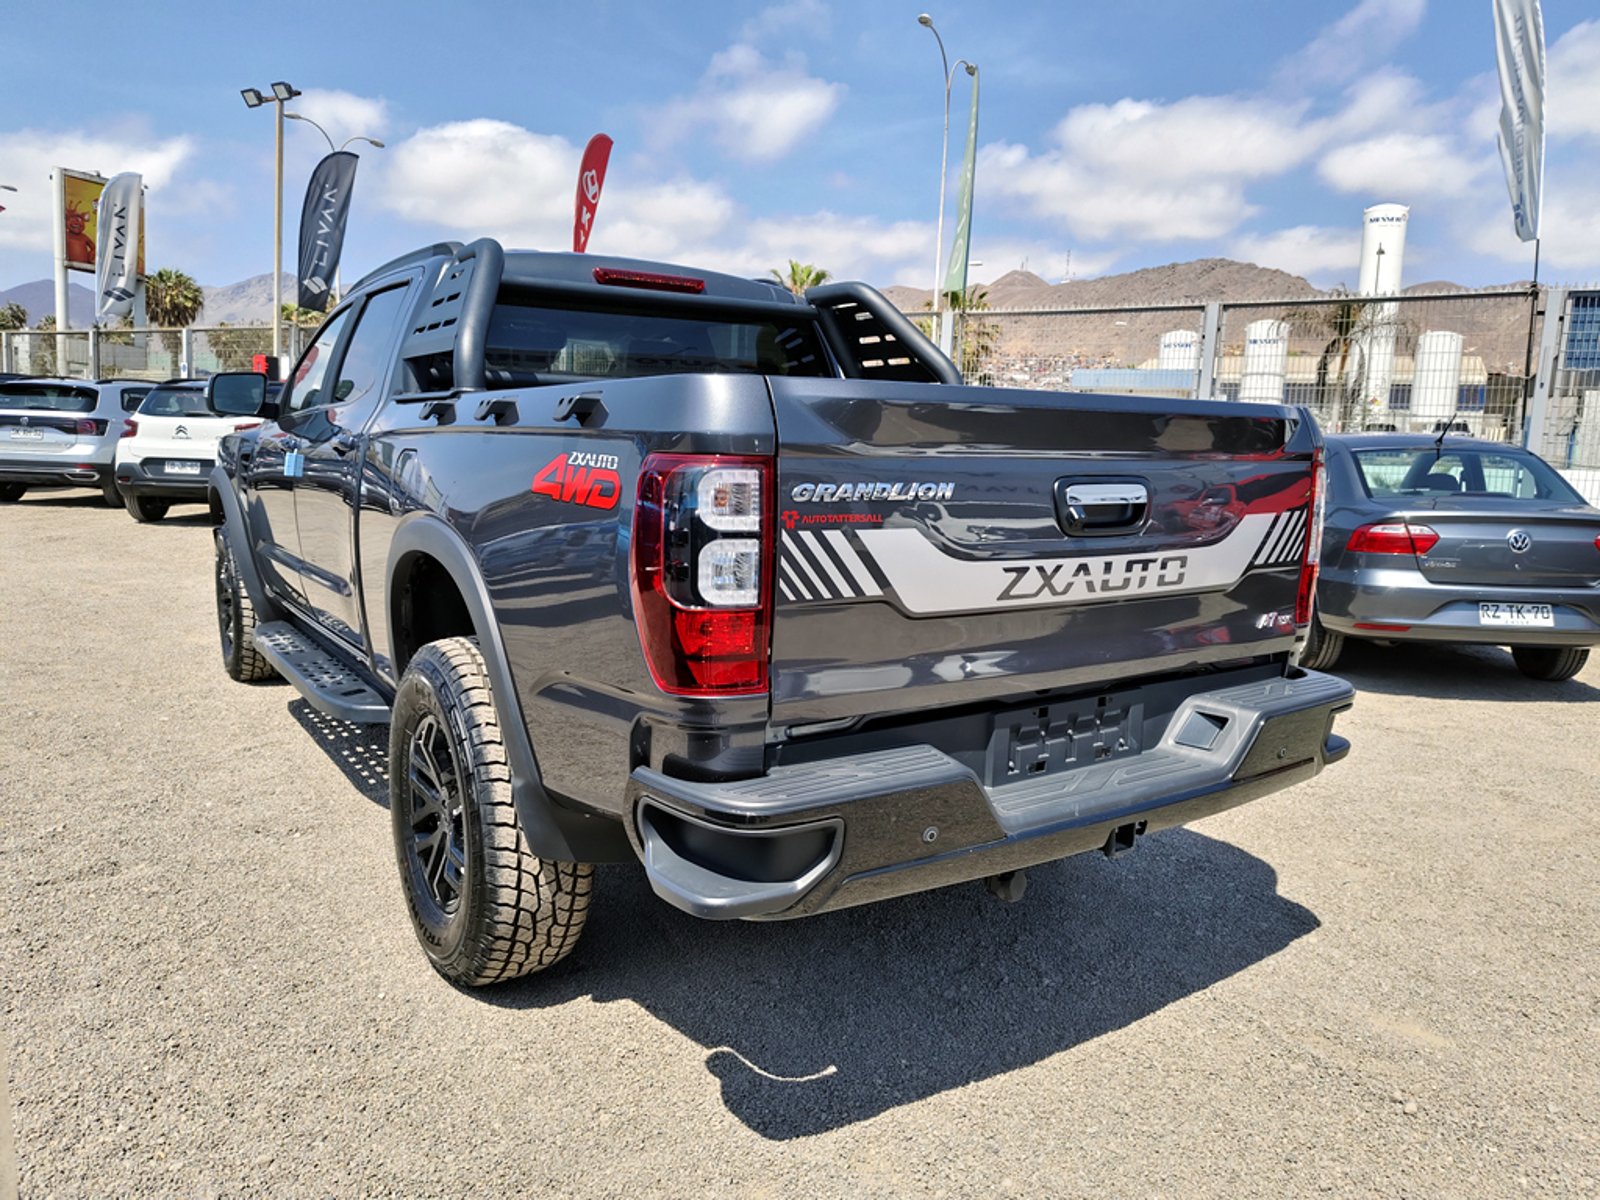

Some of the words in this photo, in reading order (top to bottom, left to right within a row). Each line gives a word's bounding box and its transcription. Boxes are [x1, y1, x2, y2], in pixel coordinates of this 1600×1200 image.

[112, 203, 126, 277] LIVAN
[314, 183, 338, 267] LIVAN
[531, 453, 621, 511] 4WD
[567, 451, 619, 470] ZXAUTO
[791, 481, 956, 502] GRANDLION
[996, 555, 1188, 601] ZXAUTO
